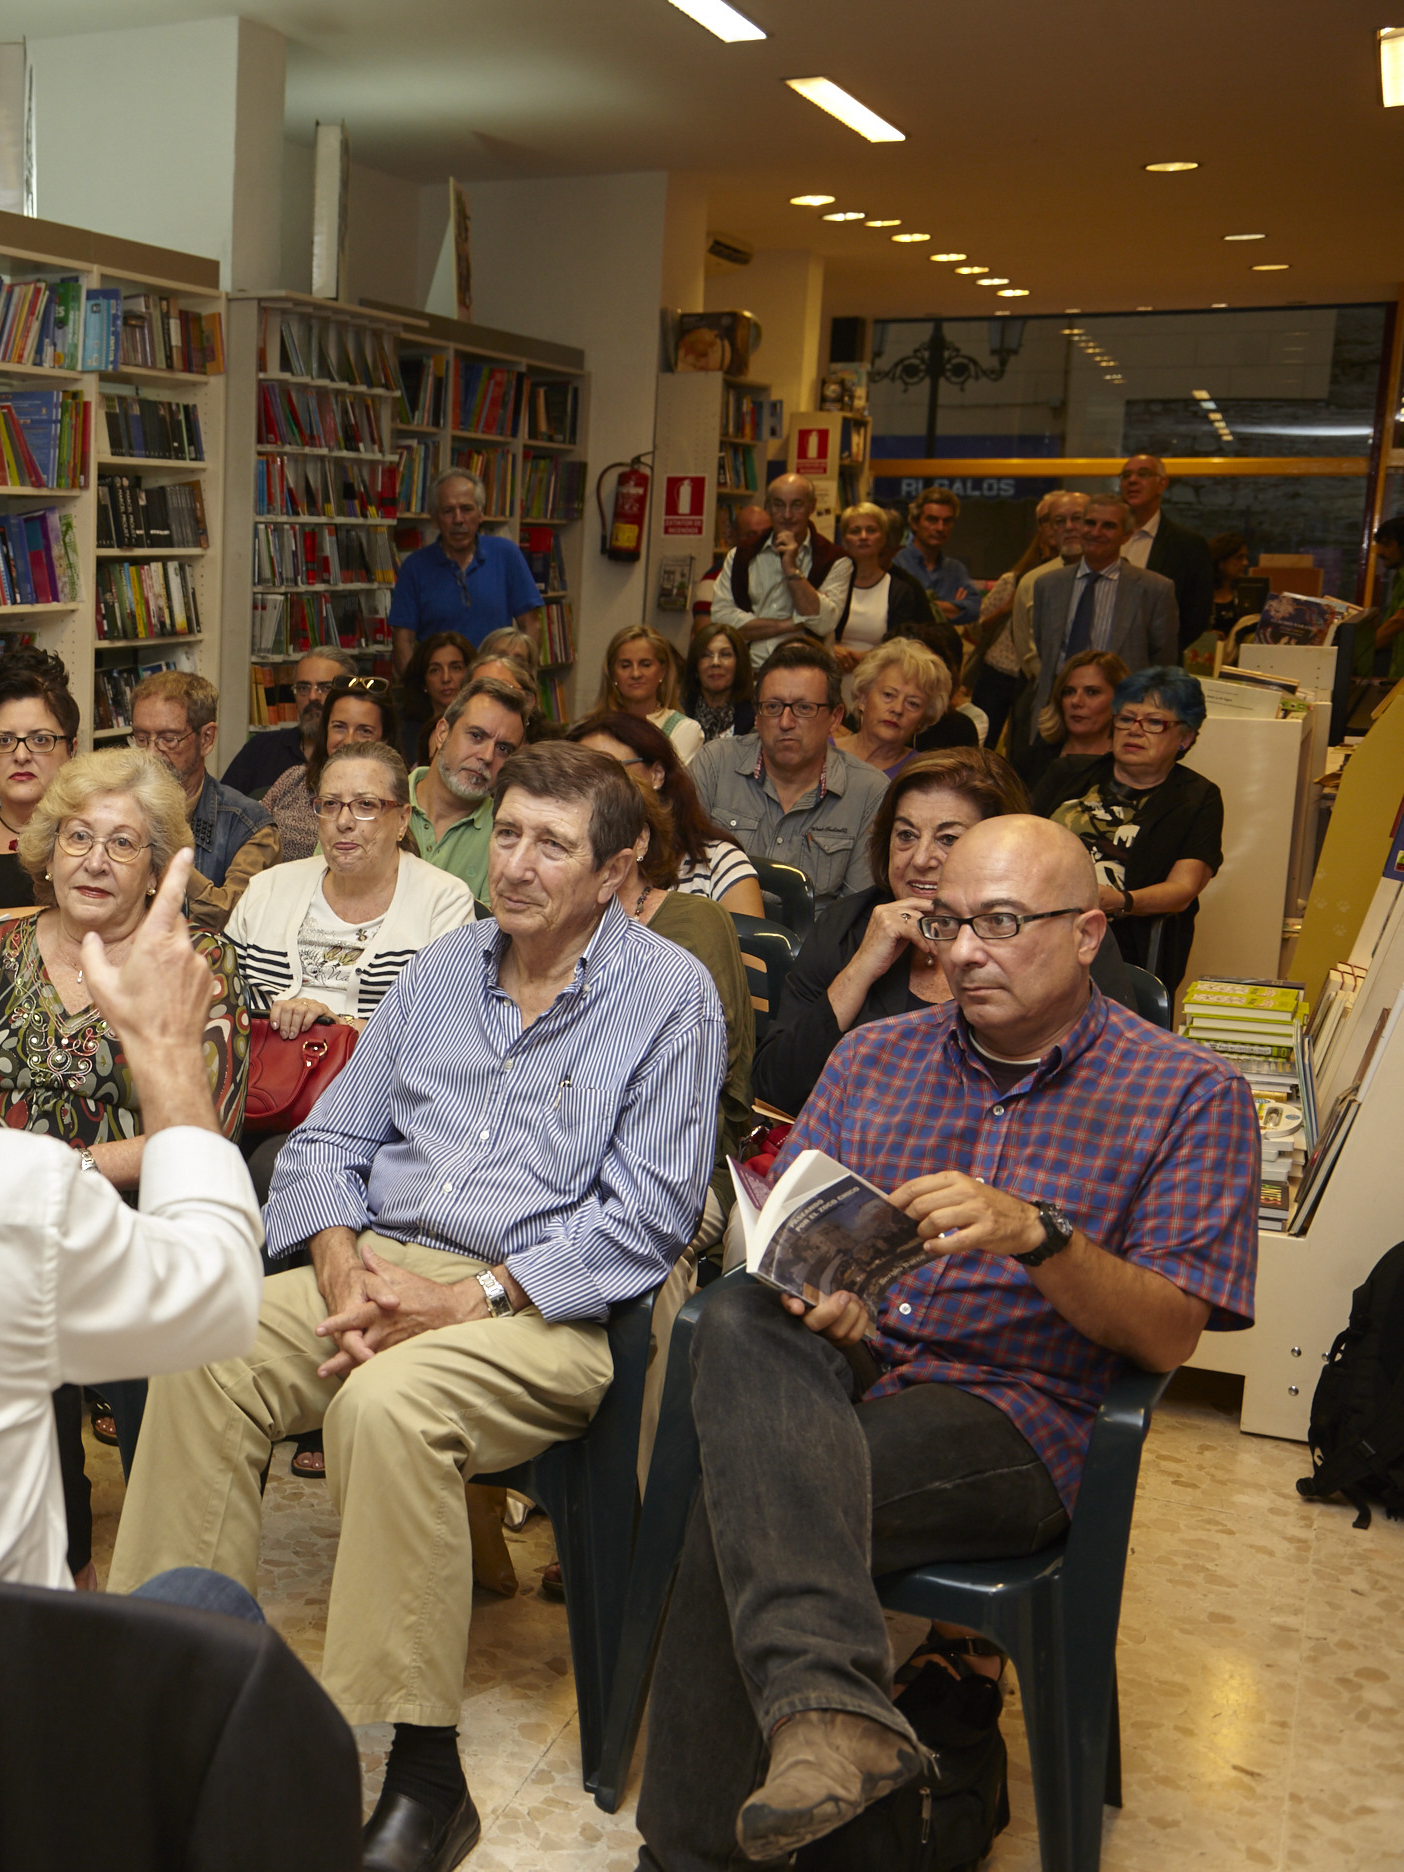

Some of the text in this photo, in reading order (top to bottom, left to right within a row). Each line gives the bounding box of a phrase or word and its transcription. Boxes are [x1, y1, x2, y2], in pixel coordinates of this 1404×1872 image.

[121, 514, 129, 538] PROUST
[790, 1199, 825, 1228] PASEANDO
[795, 1186, 860, 1232] POR EL ZOCO CHICO
